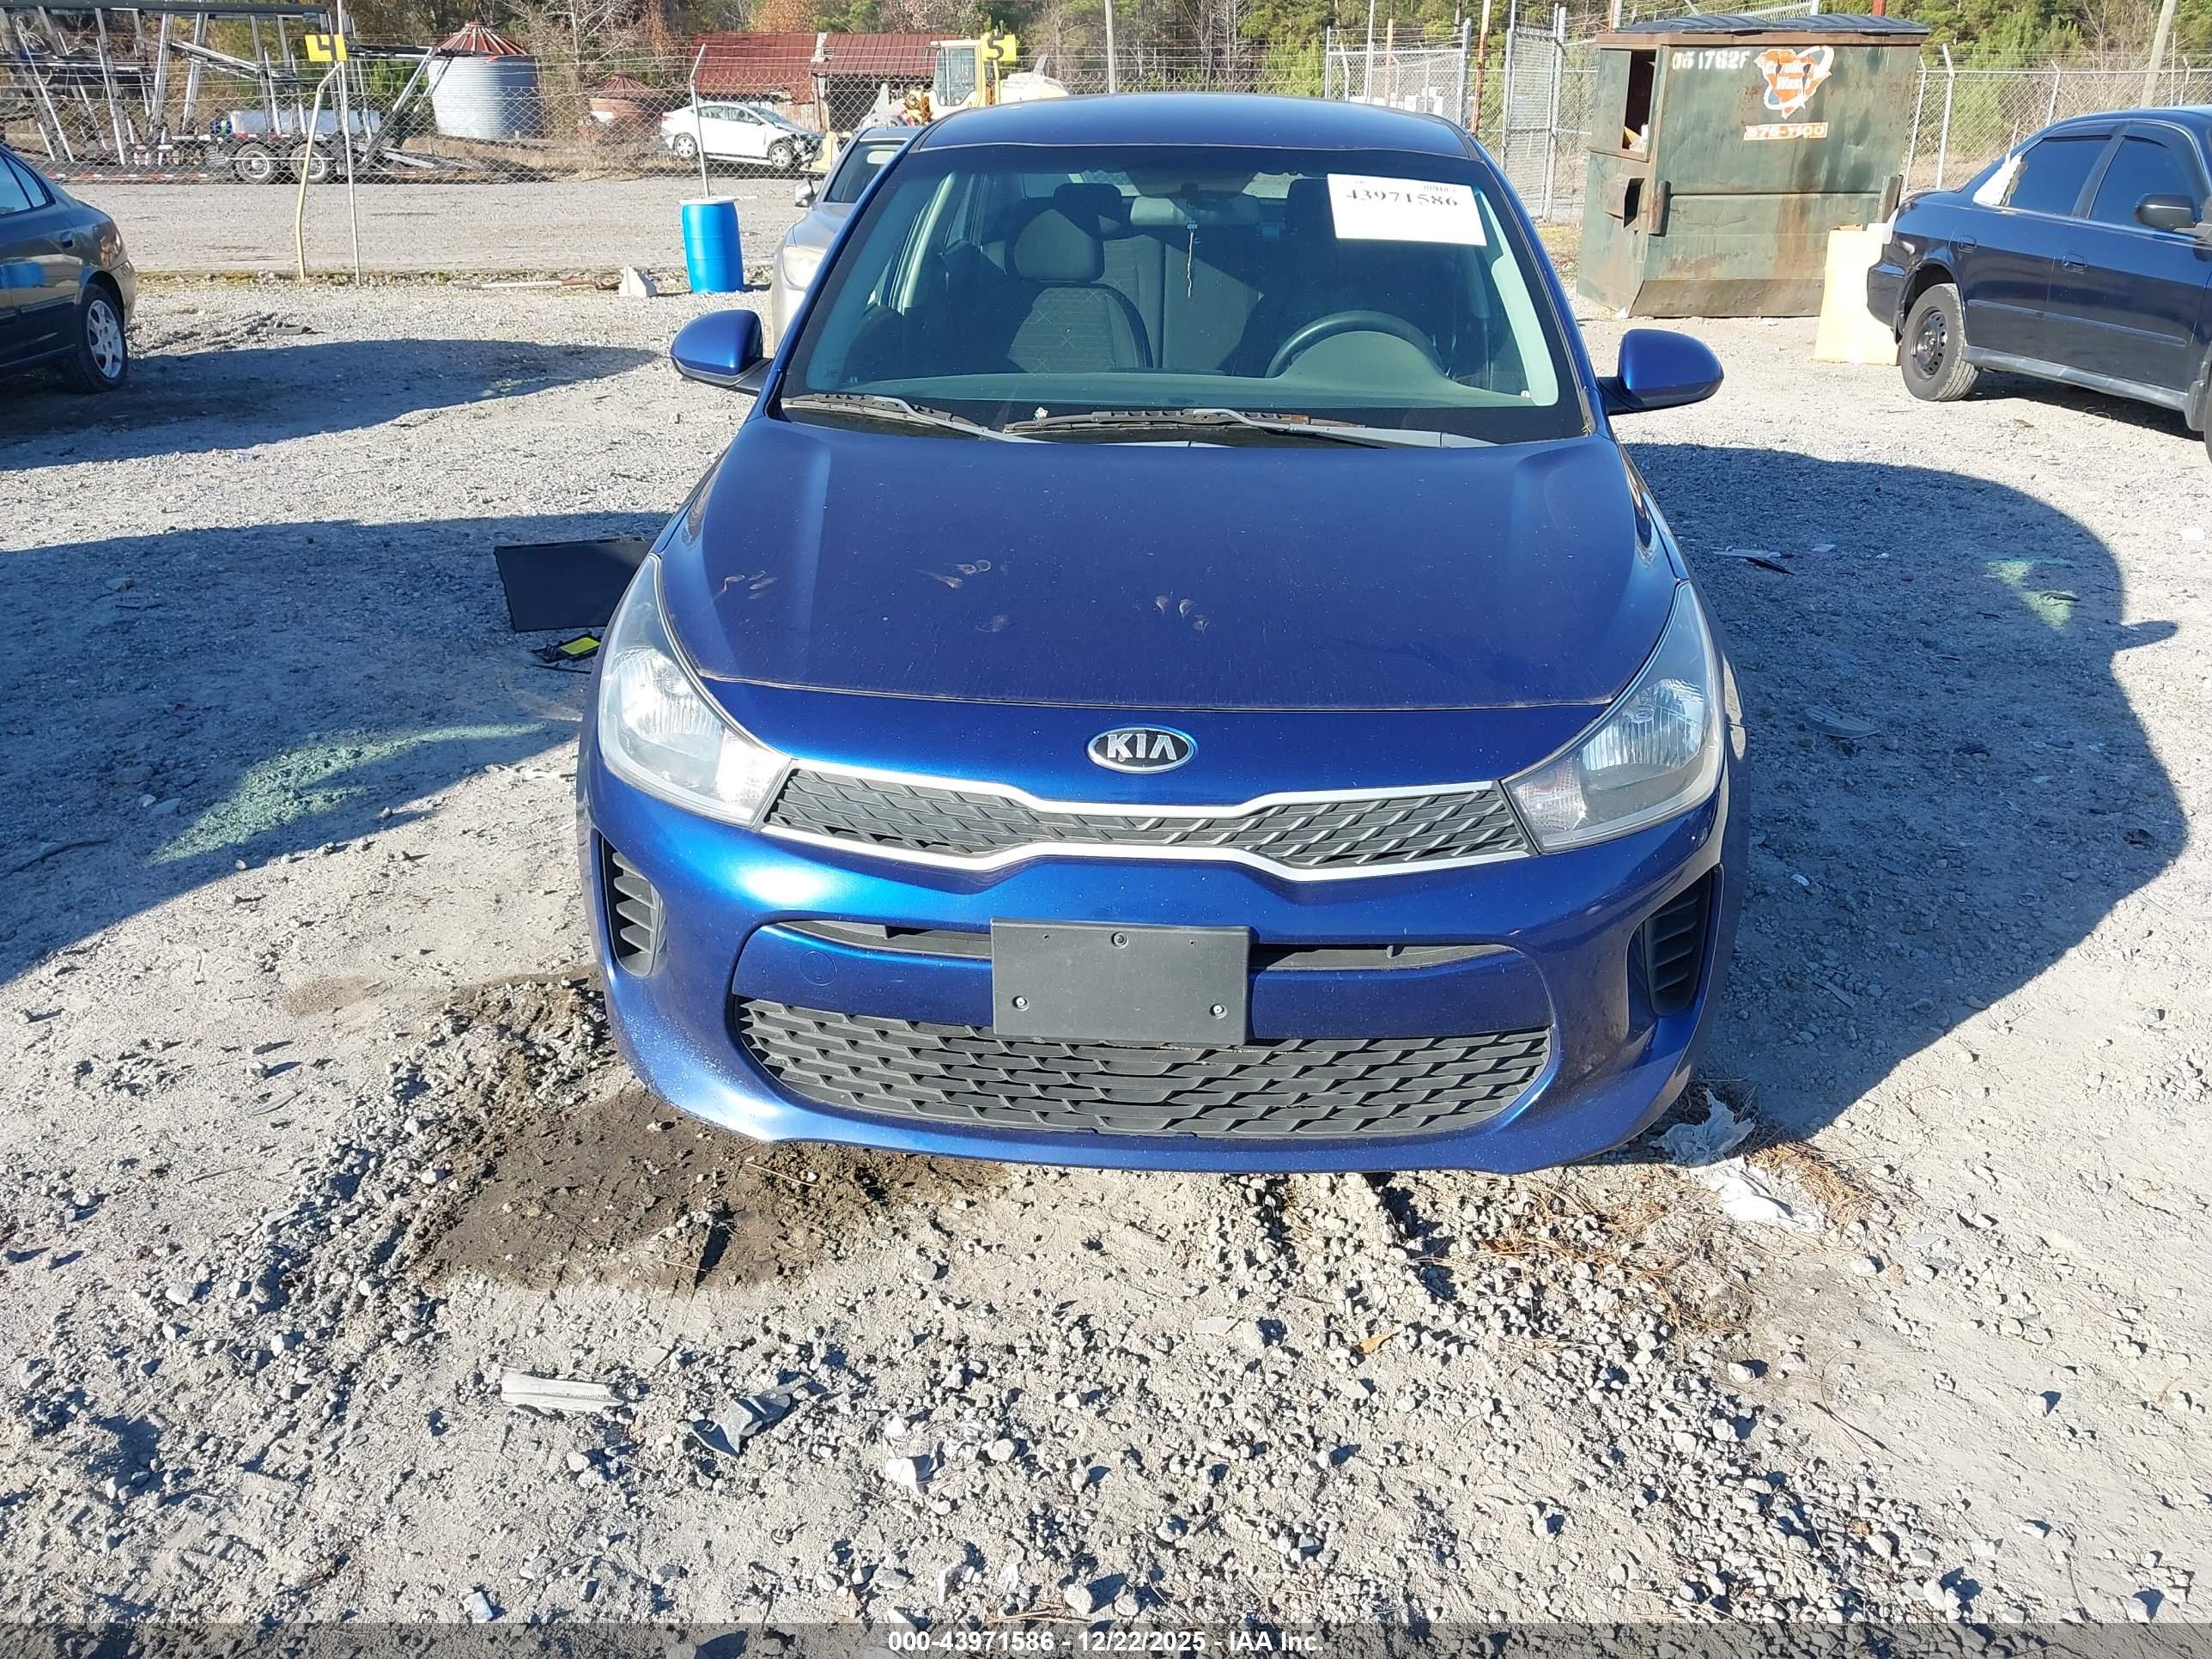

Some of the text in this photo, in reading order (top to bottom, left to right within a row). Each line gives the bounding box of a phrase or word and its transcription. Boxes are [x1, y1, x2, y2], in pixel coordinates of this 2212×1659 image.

[316, 34, 337, 61] 4
[987, 33, 1006, 60] 5
[1346, 188, 1458, 207] 43971586
[1107, 733, 1177, 761] KIA
